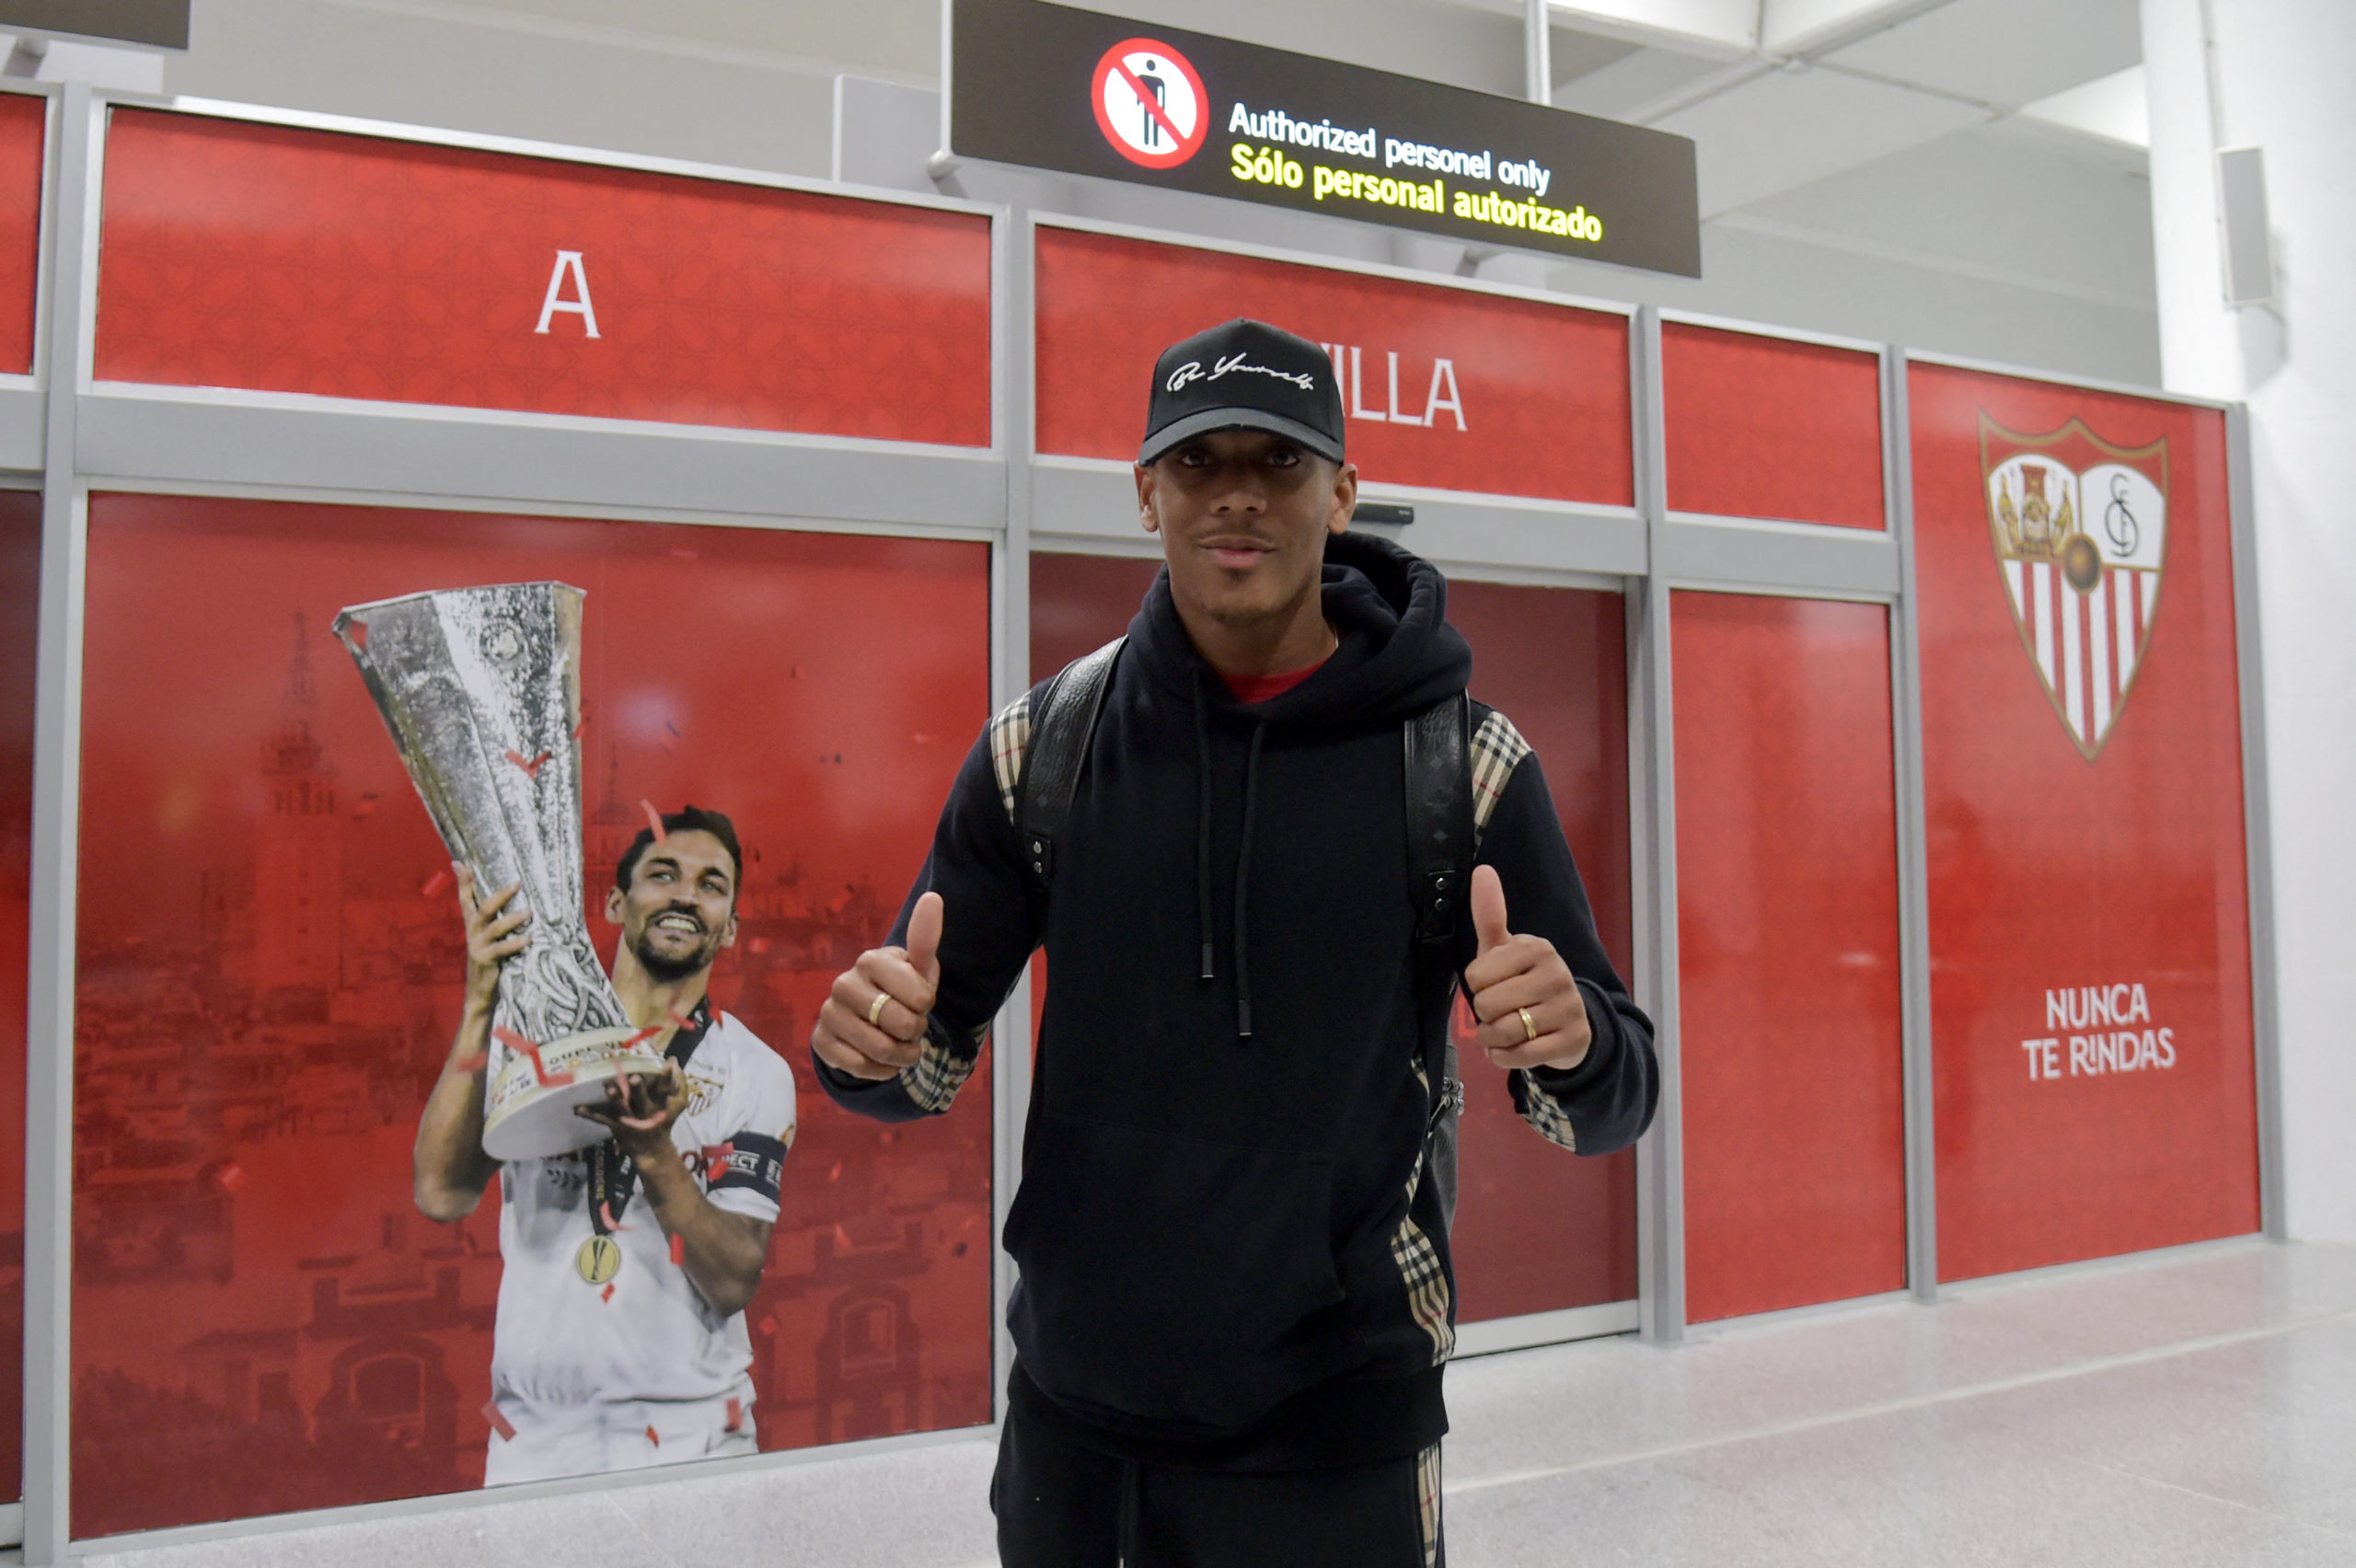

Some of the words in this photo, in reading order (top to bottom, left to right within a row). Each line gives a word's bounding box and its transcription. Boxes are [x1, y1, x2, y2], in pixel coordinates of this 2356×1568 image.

[1229, 102, 1377, 158] Authorized
[1385, 138, 1491, 180] personel
[1498, 159, 1551, 197] only
[1231, 143, 1304, 189] Sólo
[1313, 165, 1445, 214] personal
[1453, 190, 1603, 242] autorizado
[534, 249, 602, 340] A
[1320, 342, 1469, 432] ILLA
[2045, 983, 2151, 1031] NUNCA
[2021, 1037, 2062, 1081] TE
[2069, 1026, 2177, 1077] RINDAS
